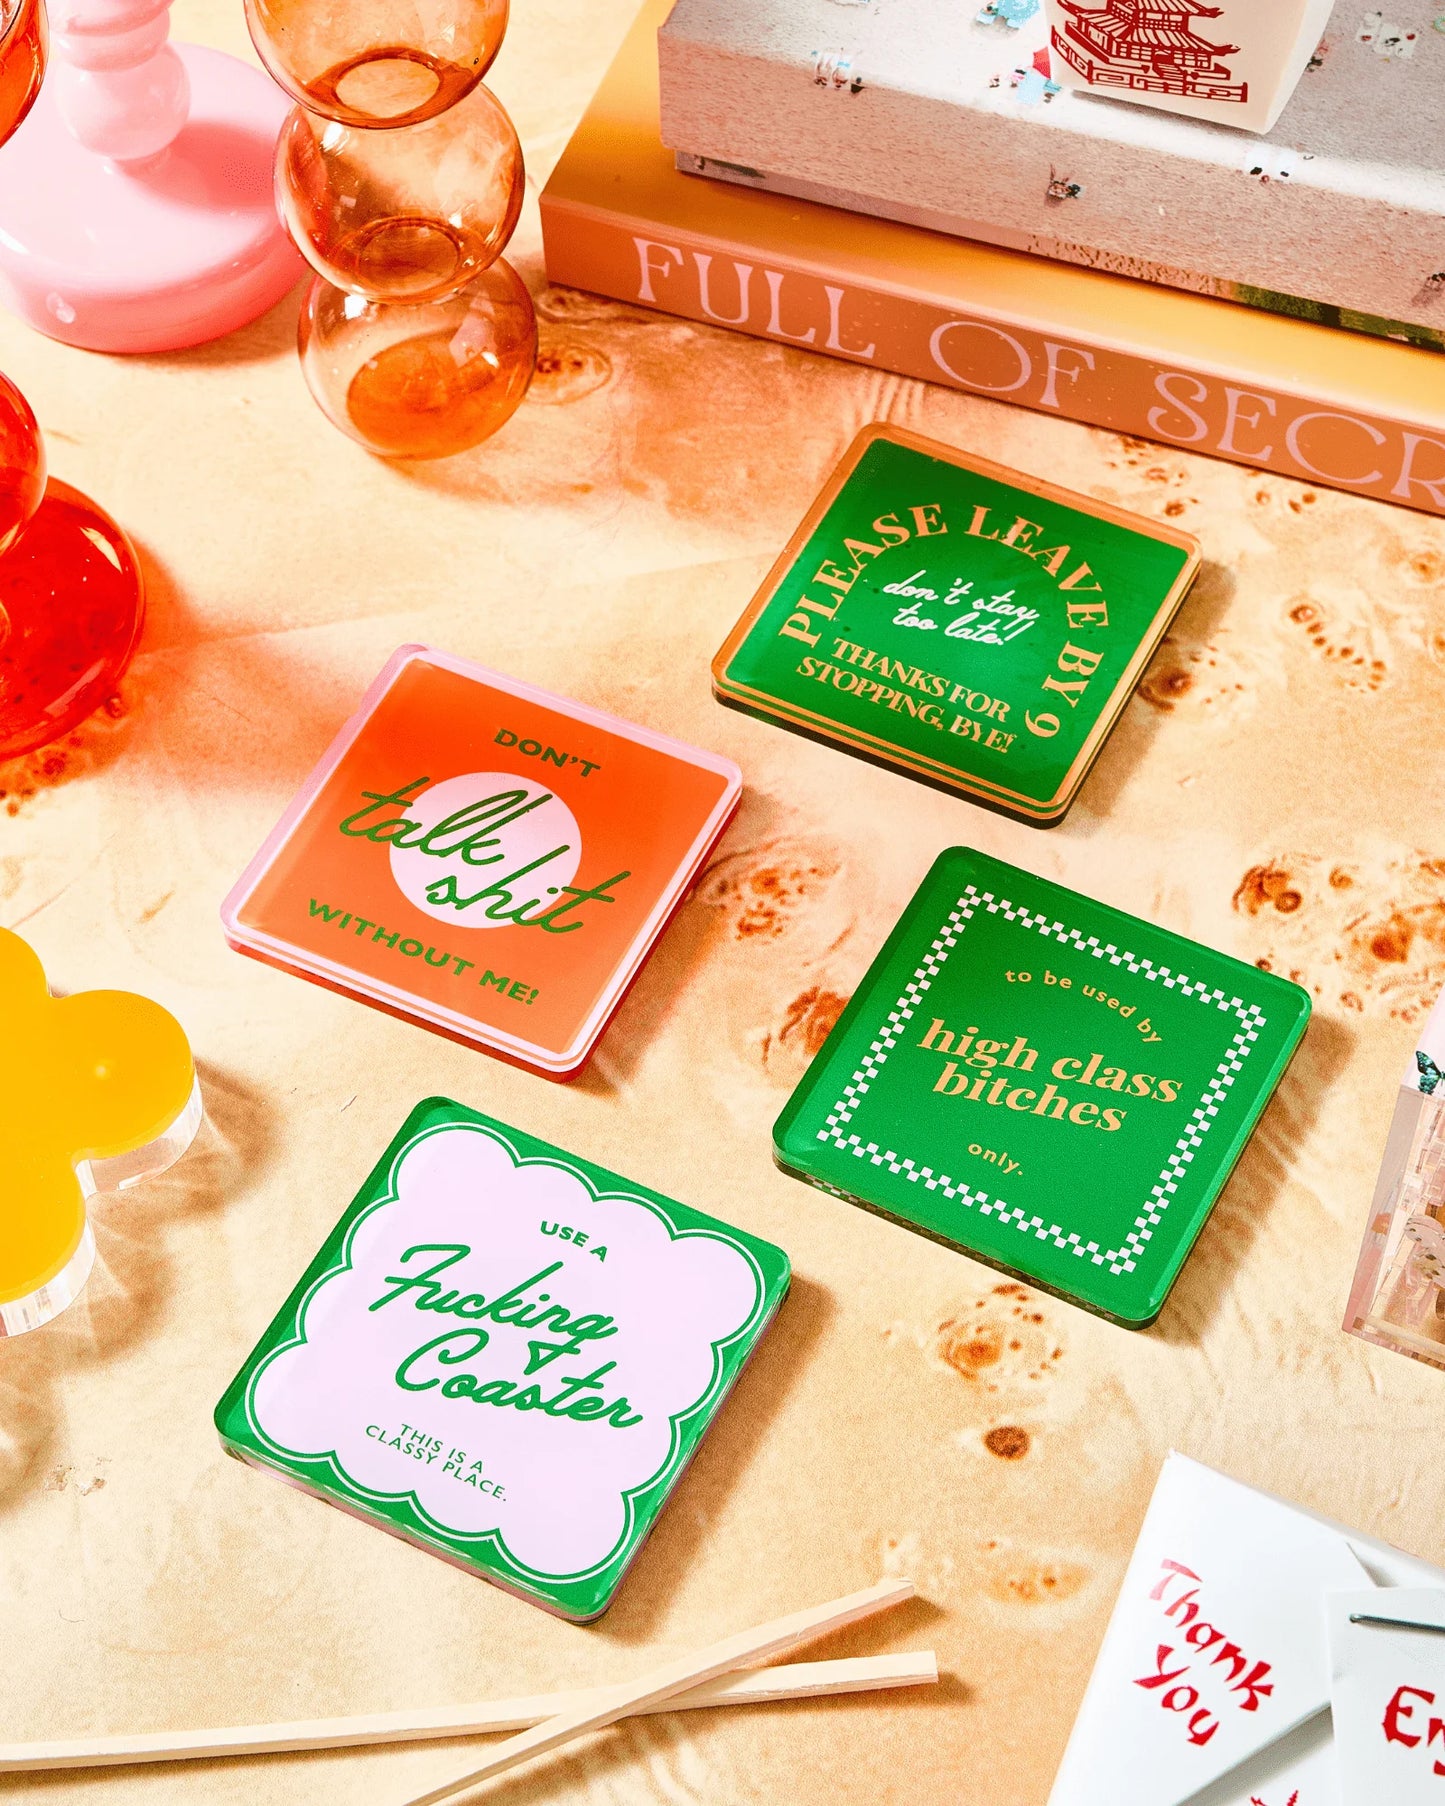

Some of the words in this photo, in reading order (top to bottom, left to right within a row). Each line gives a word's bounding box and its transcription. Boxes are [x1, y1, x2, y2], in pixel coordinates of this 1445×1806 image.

[632, 237, 876, 360] FULL
[929, 320, 1096, 409] OF
[1147, 372, 1445, 508] SECR
[778, 503, 949, 649] PLEASE
[883, 569, 974, 606] don't
[972, 589, 1040, 631] stay
[964, 504, 1109, 629] LEAVE
[892, 602, 938, 631] too
[795, 655, 945, 731] STOPPING,
[949, 714, 1018, 754] BYE!
[831, 637, 952, 698] THANKS
[948, 683, 1011, 723] FOR
[1041, 640, 1105, 709] BY
[493, 728, 602, 778] DON'T
[1024, 709, 1061, 738] 9
[339, 776, 554, 866] talk
[425, 844, 632, 934] shit
[308, 898, 475, 976] WITHOUT
[479, 970, 540, 1006] ME!
[1004, 969, 1032, 983] to
[1043, 969, 1073, 989] be
[1081, 983, 1138, 1019] used
[1136, 1017, 1163, 1044] by
[916, 1017, 1040, 1073] high
[1051, 1052, 1183, 1103] class
[932, 1061, 1128, 1132] bitches
[967, 1142, 1024, 1177] only.
[540, 1220, 590, 1248] USE
[590, 1245, 608, 1262] A
[368, 1243, 619, 1375] Fucking
[395, 1327, 644, 1428] Coaster
[365, 1424, 438, 1465] CLASSY
[442, 1461, 507, 1502] PLACE.
[400, 1423, 444, 1453] THIS
[448, 1447, 468, 1464] IS
[469, 1460, 483, 1474] A
[1149, 1558, 1275, 1712] Thank
